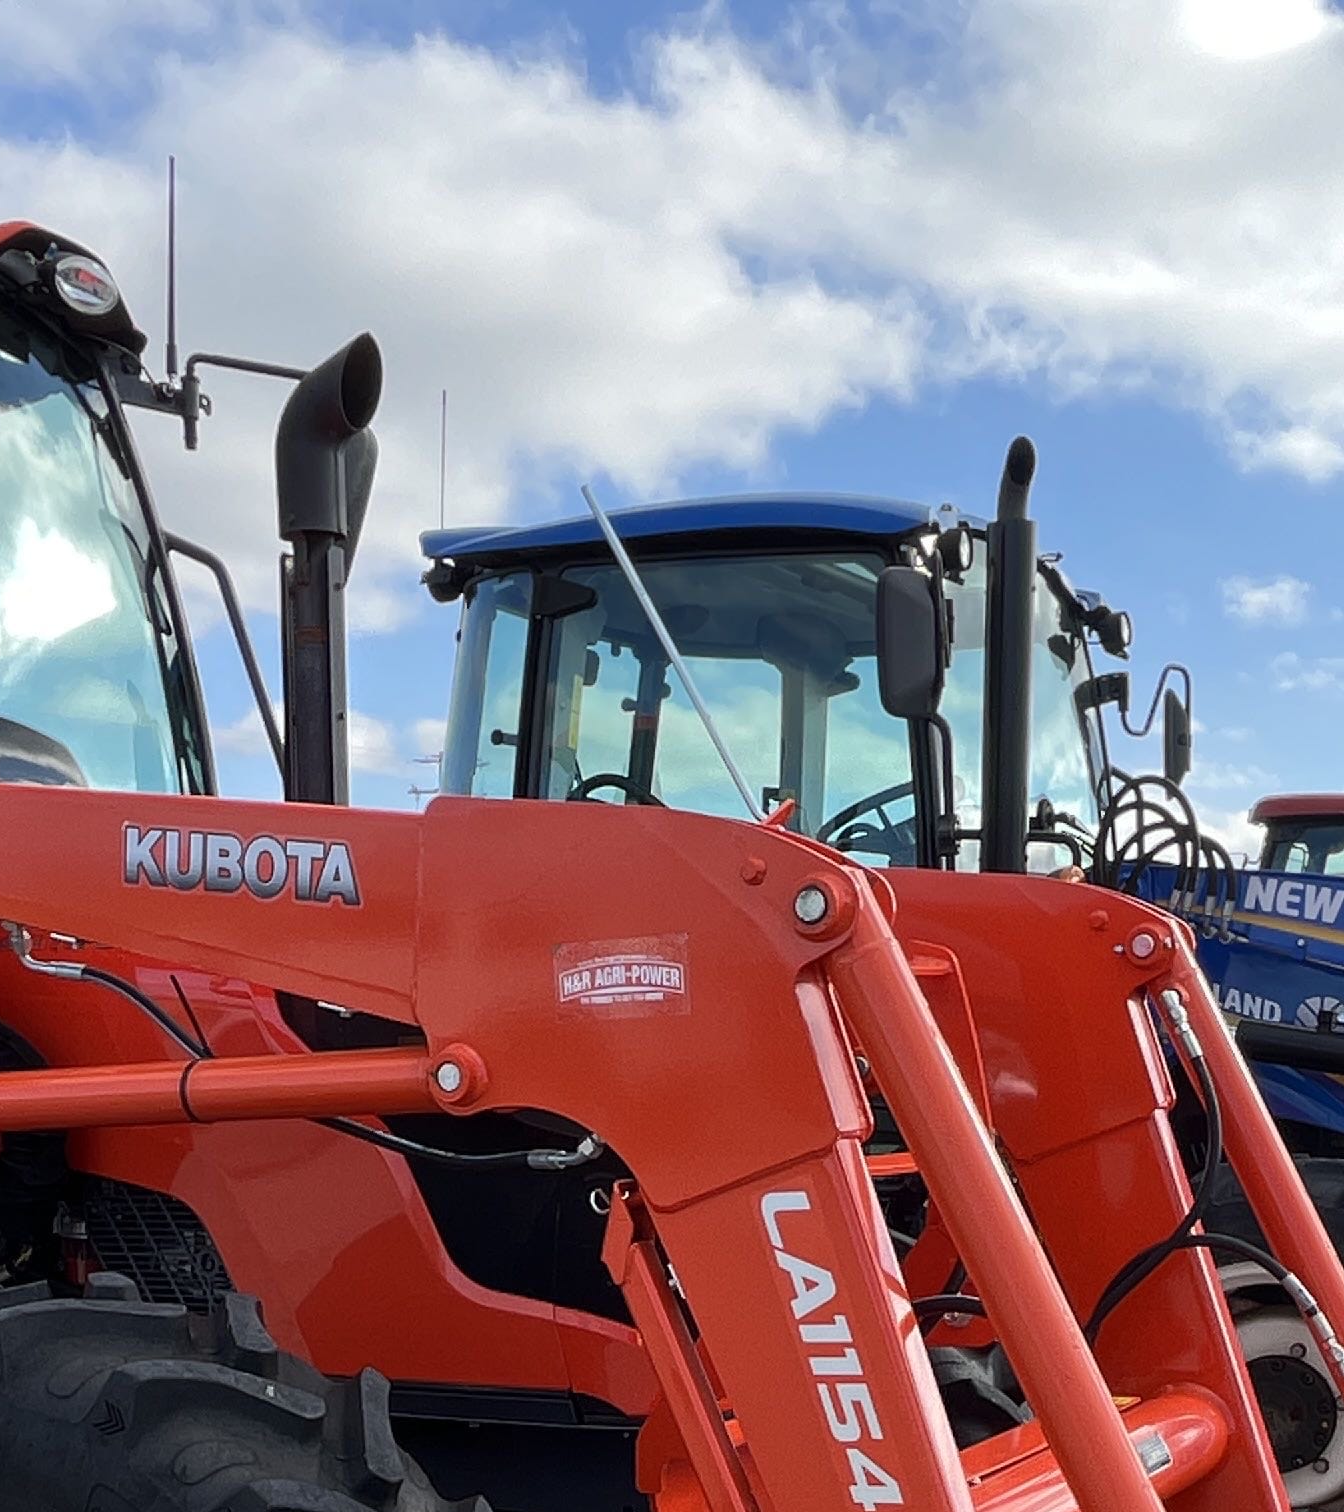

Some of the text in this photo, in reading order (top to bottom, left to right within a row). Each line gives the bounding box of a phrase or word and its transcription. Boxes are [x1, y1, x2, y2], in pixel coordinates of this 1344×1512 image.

[124, 824, 361, 906] KUBOTA
[563, 964, 682, 996] H&R AGRI-POWER
[760, 1190, 904, 1512] LA1154
